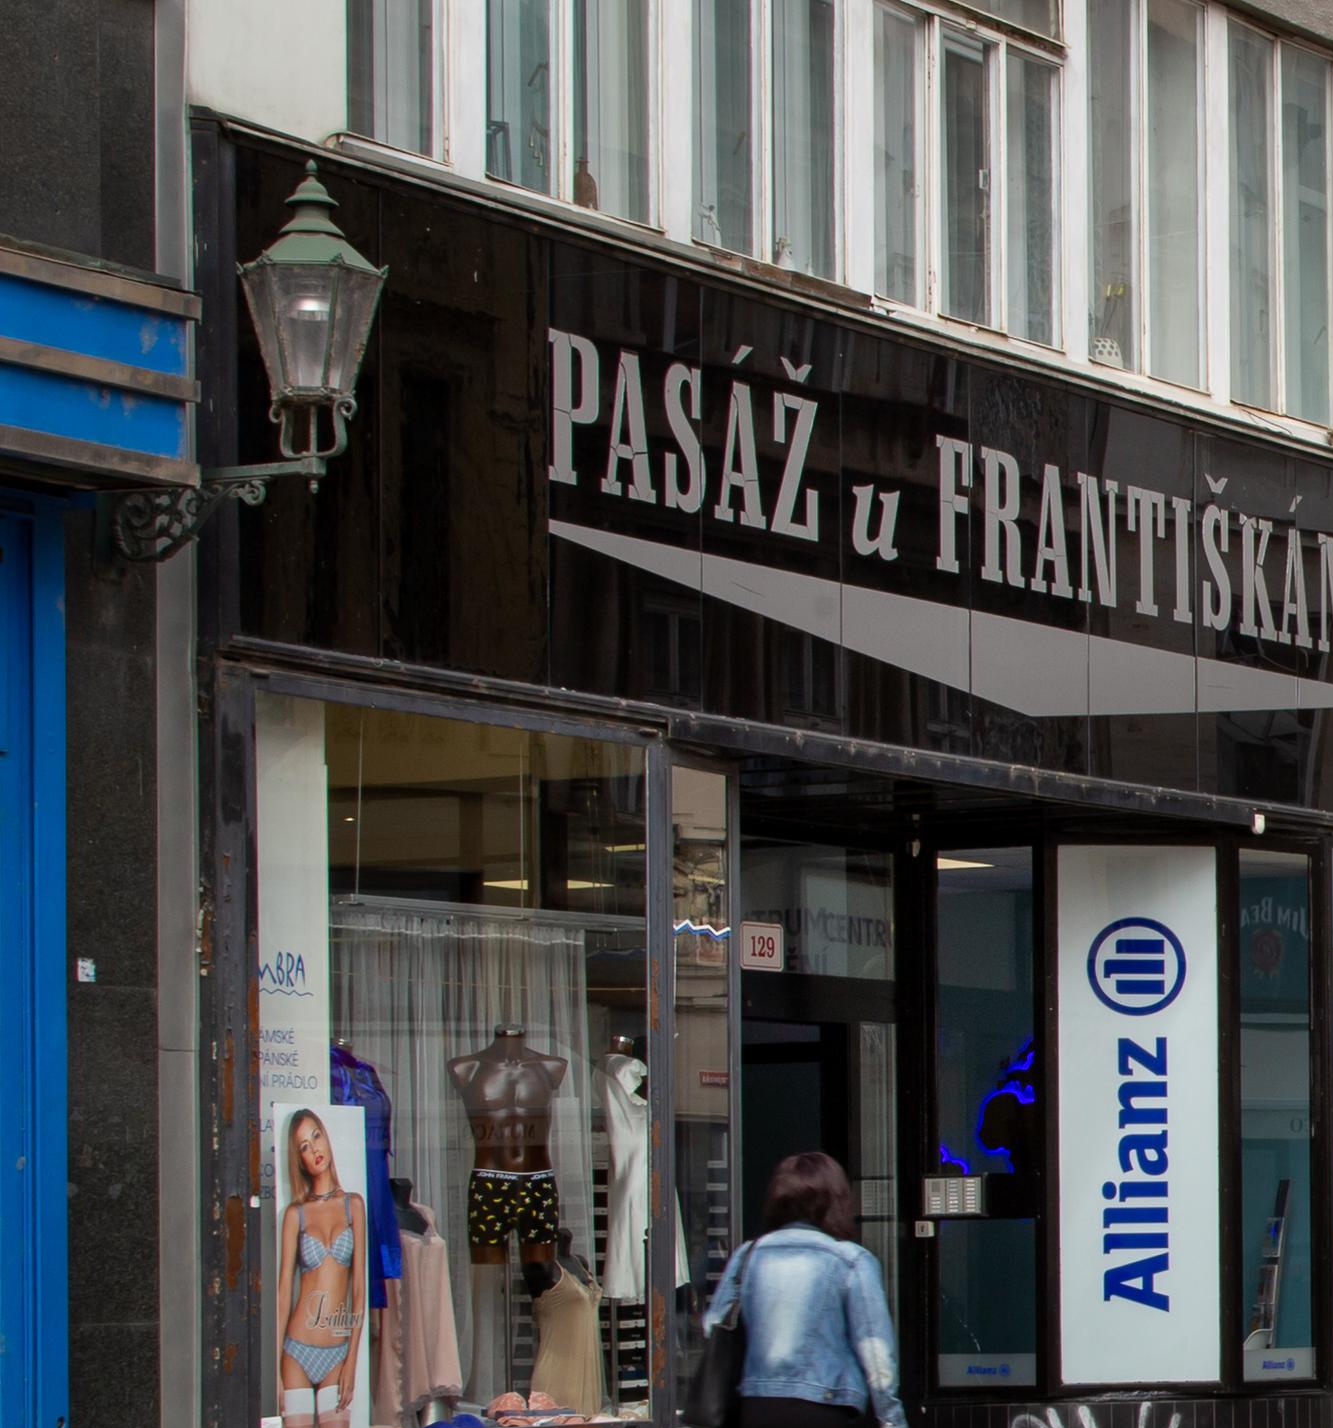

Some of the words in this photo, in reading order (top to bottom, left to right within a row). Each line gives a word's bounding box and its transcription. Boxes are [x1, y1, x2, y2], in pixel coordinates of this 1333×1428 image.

[548, 327, 819, 542] PASÁŽ
[852, 484, 900, 561] u
[751, 936, 775, 958] 129
[271, 1072, 318, 1090] PRÁDLO
[1103, 1037, 1170, 1313] Allianz
